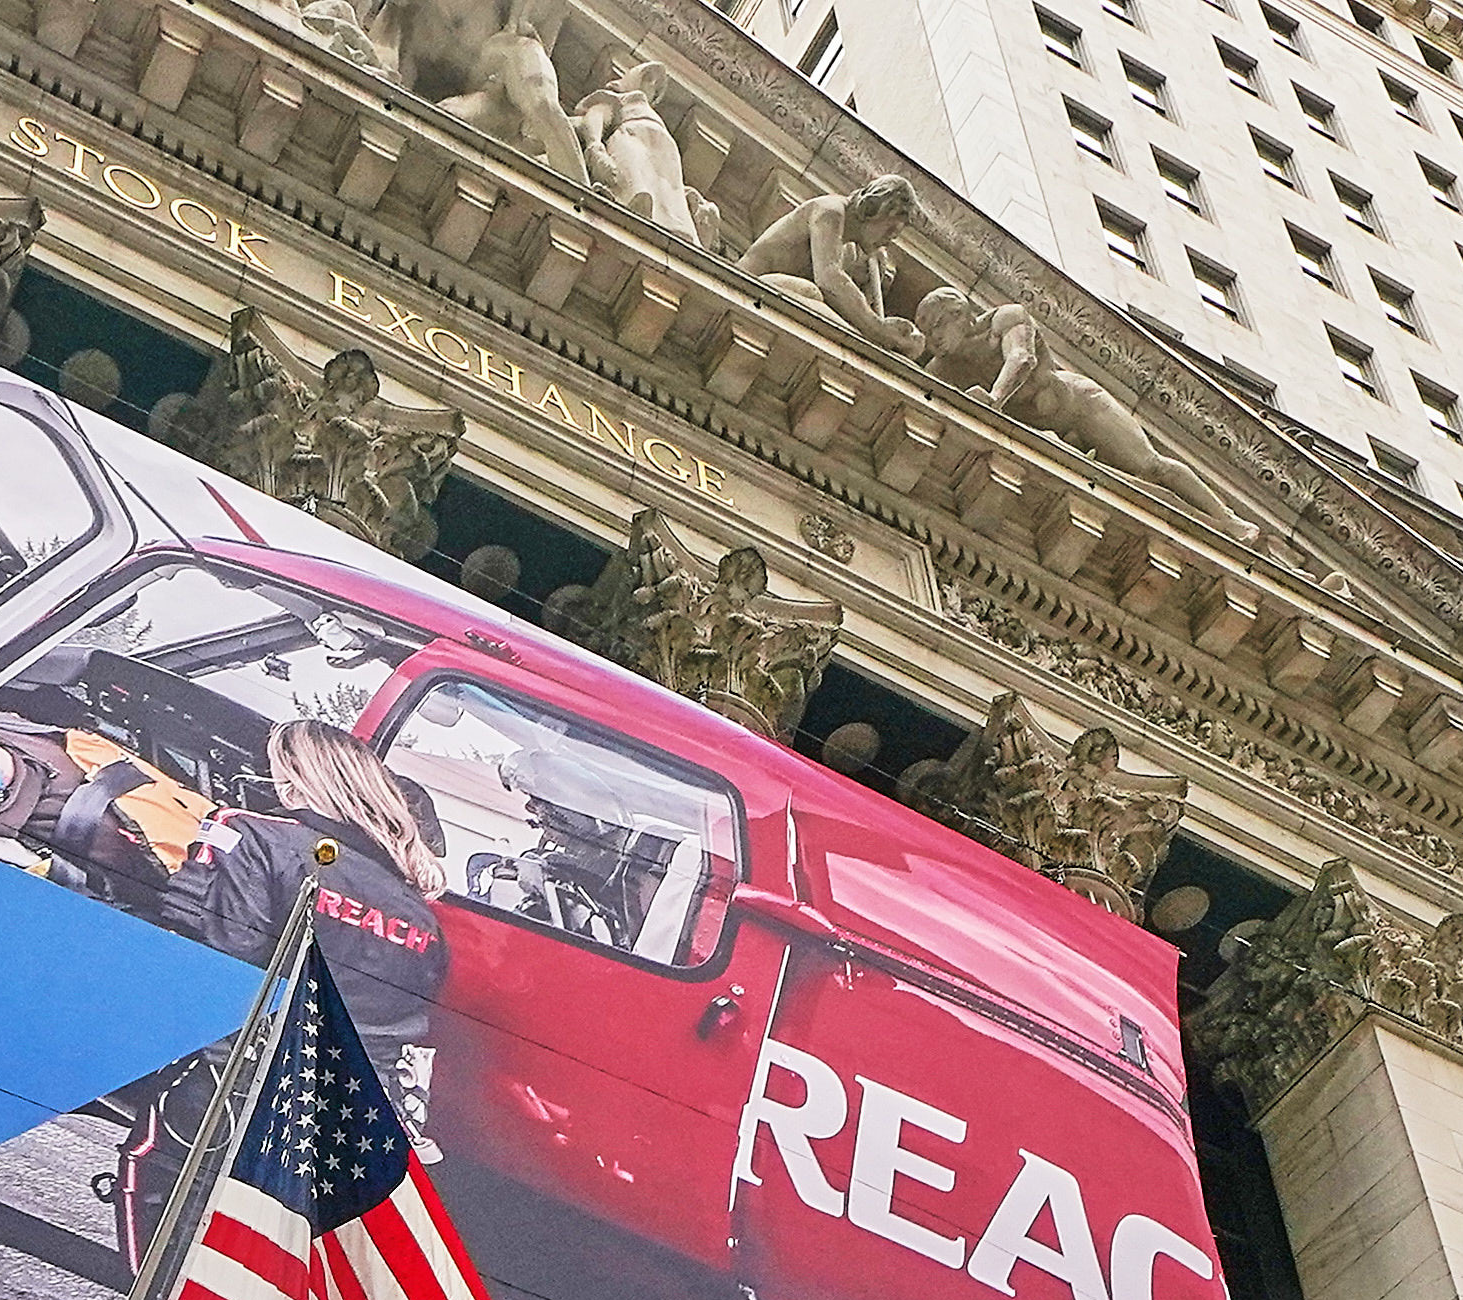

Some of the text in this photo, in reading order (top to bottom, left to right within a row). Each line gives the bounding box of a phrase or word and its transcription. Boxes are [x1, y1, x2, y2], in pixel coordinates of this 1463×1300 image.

[6, 112, 277, 275] STOCK
[327, 274, 740, 510] EXCHANGE
[315, 886, 438, 955] REACH
